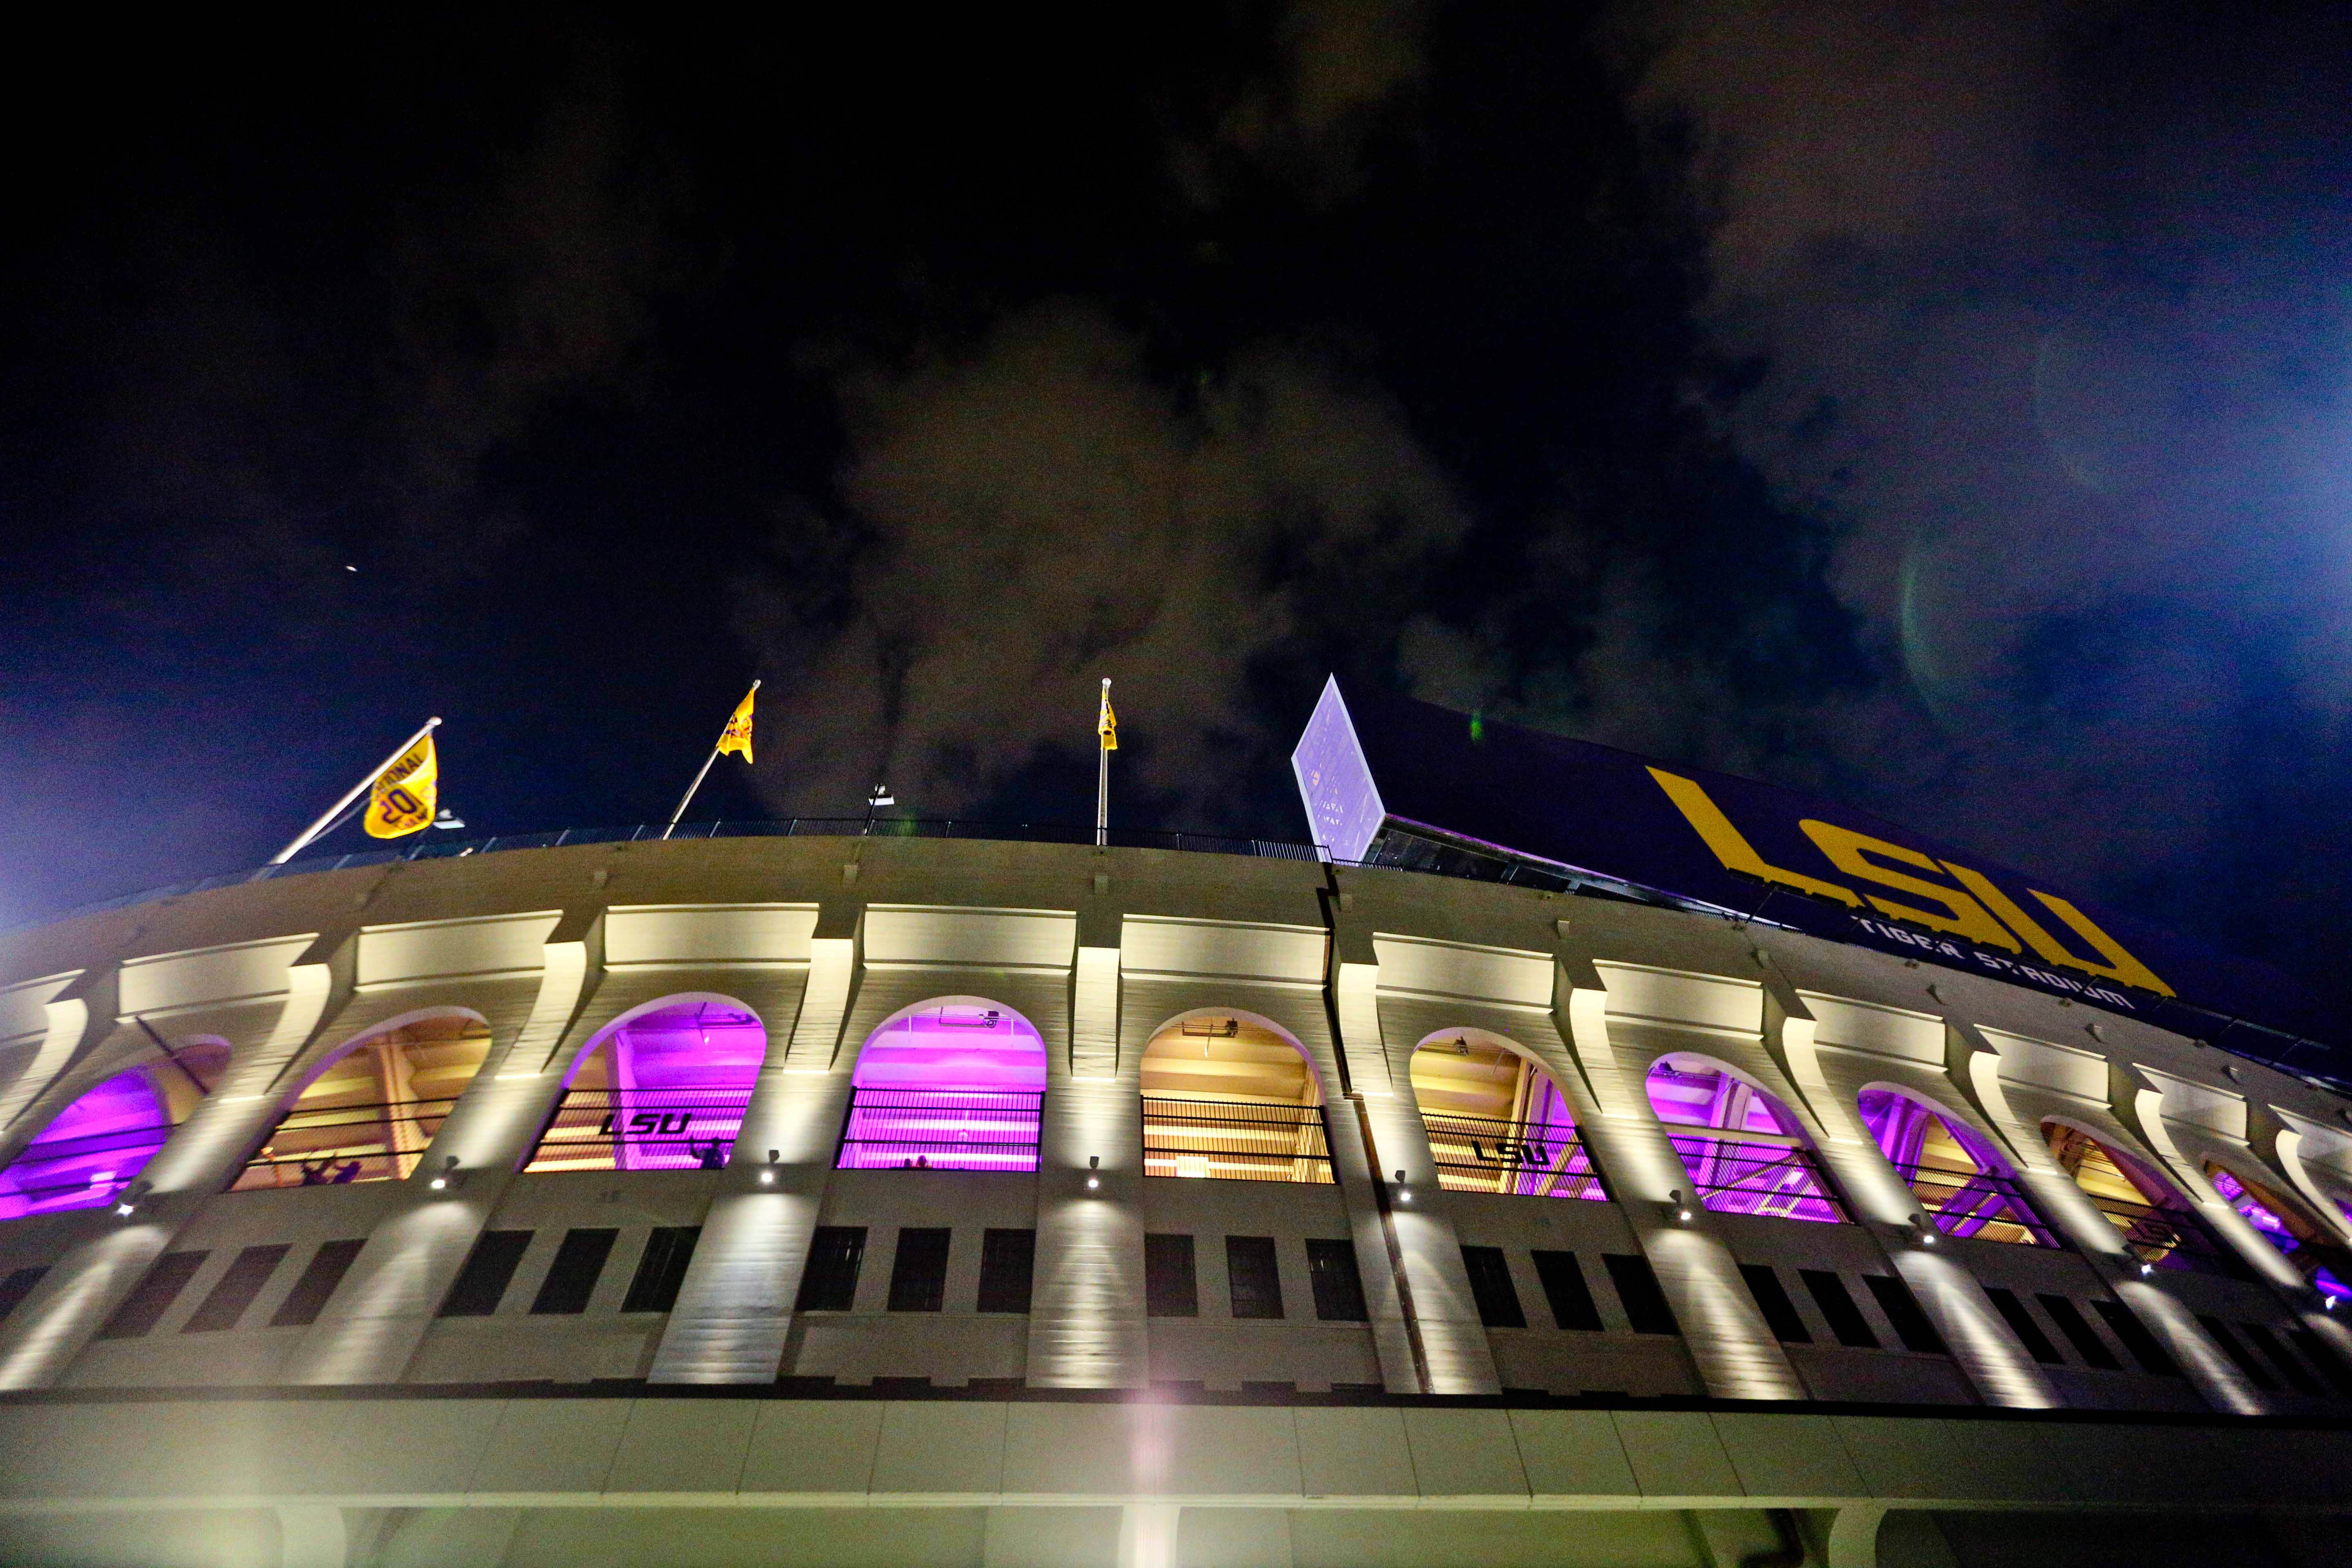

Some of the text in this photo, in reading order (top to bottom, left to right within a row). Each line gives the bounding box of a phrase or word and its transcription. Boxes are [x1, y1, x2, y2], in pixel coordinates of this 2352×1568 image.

[1646, 766, 2176, 997] LSU
[1850, 915, 2136, 1009] TIGER STADIUM
[599, 1113, 692, 1136] LSU
[1471, 1140, 1550, 1165] LSU
